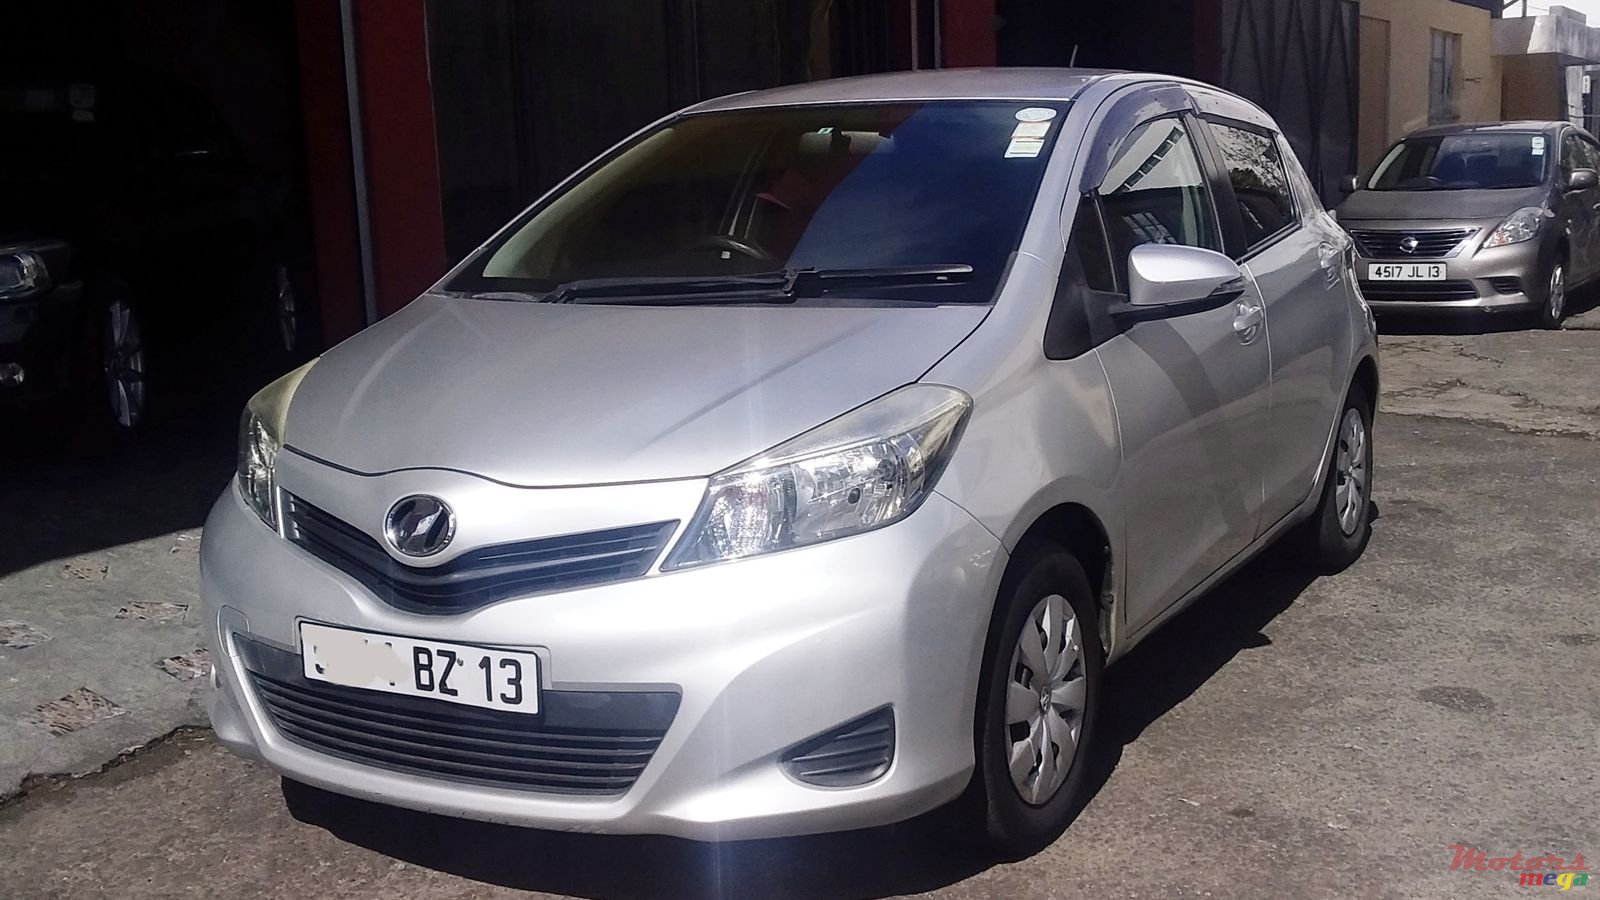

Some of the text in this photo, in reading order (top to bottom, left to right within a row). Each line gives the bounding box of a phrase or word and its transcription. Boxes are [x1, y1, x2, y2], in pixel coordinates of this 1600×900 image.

[1375, 266, 1440, 278] 4517 JL 13
[413, 646, 458, 697] BZ
[478, 655, 522, 705] 13
